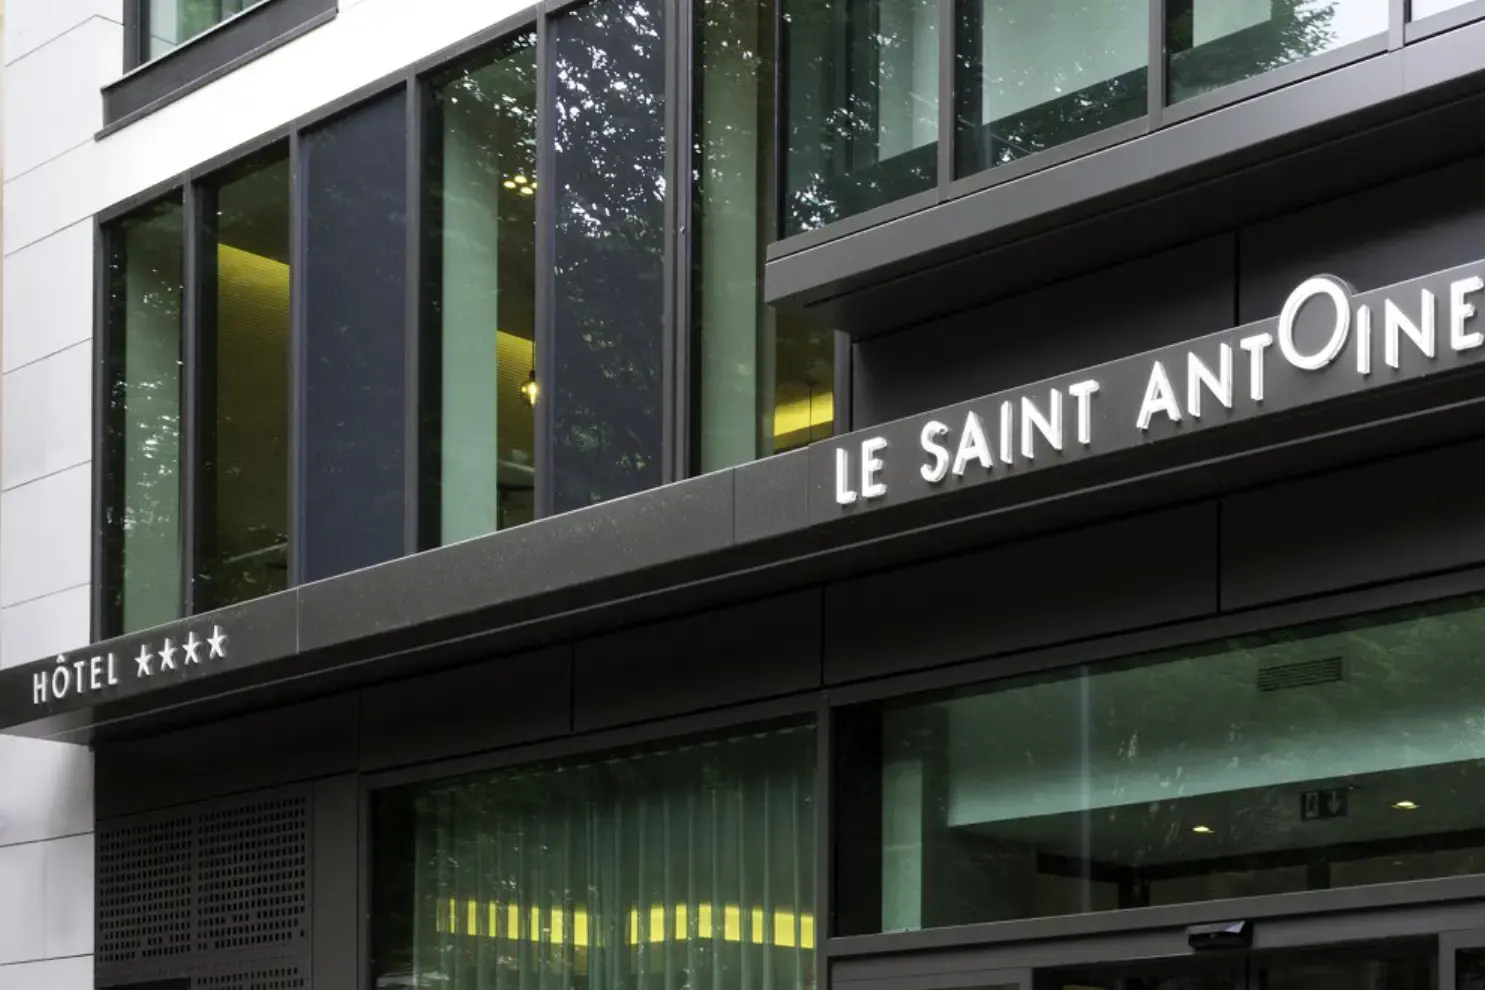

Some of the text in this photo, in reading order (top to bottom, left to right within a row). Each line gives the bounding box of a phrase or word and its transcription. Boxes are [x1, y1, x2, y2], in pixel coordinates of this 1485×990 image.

[835, 274, 1485, 505] LE SAINT ANTOINE
[33, 653, 118, 704] HÔTEL
